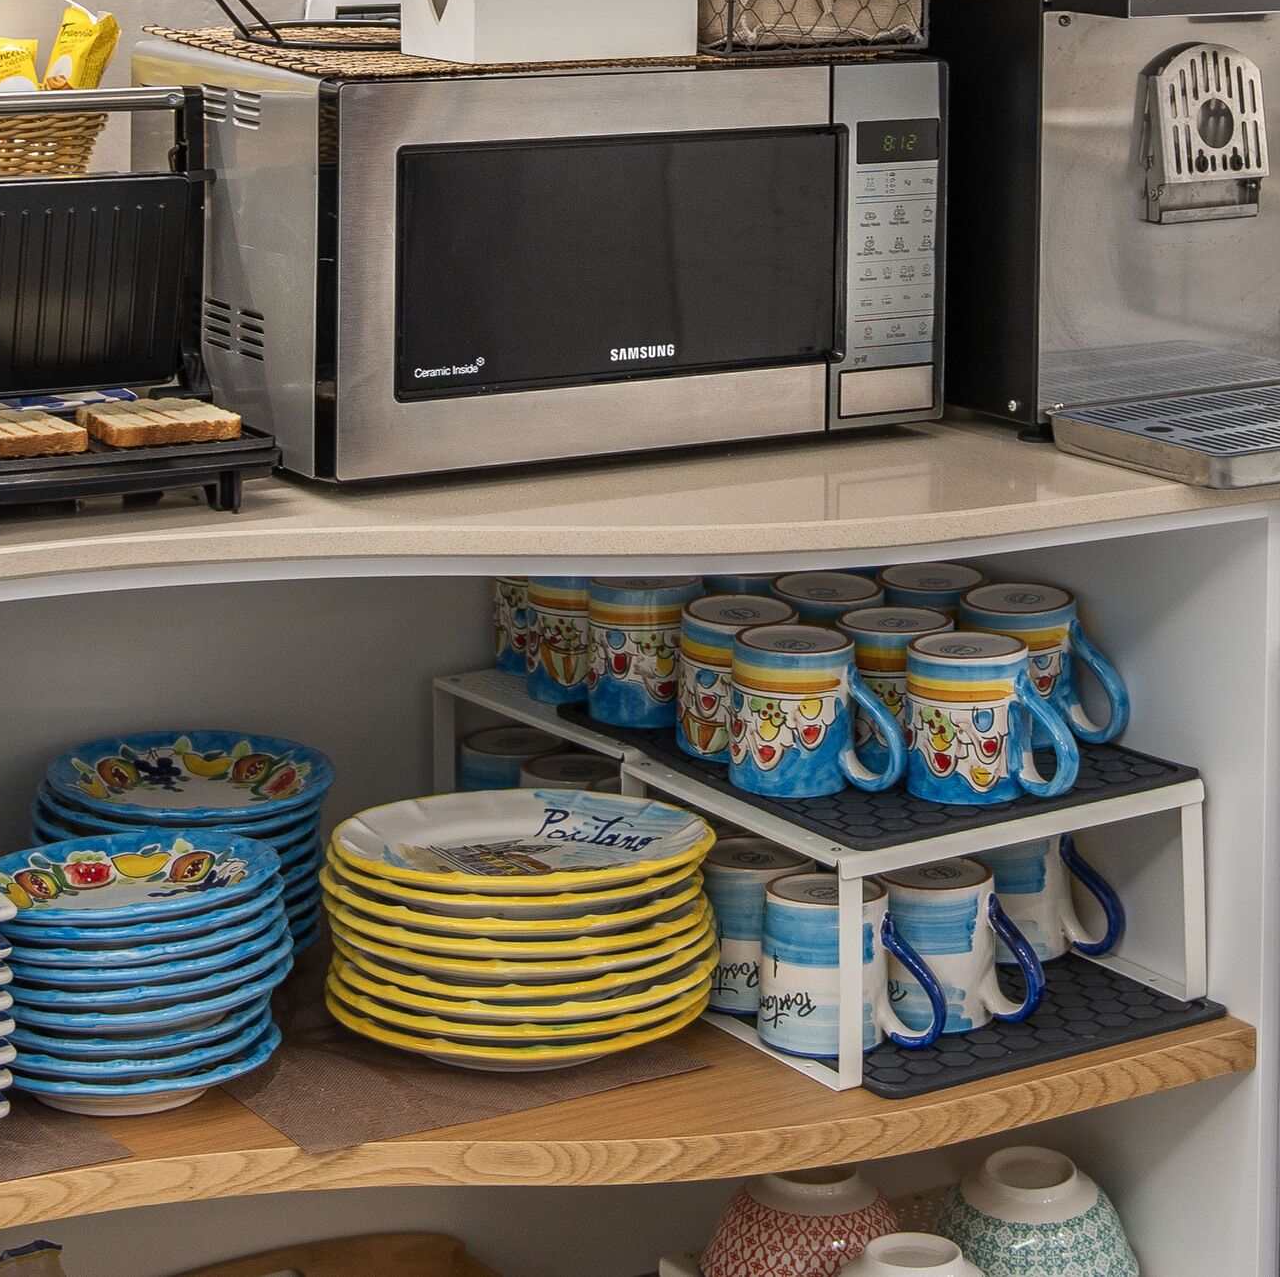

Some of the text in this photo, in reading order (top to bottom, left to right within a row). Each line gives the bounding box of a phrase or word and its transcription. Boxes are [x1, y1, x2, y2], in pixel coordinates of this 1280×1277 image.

[883, 134, 917, 152] 8:12
[610, 343, 675, 362] SAMSUNG
[854, 354, 868, 365] grill
[414, 363, 479, 379] Ceramic Inside
[533, 808, 663, 852] Positano
[710, 961, 760, 995] Posit
[759, 991, 817, 1029] Positan
